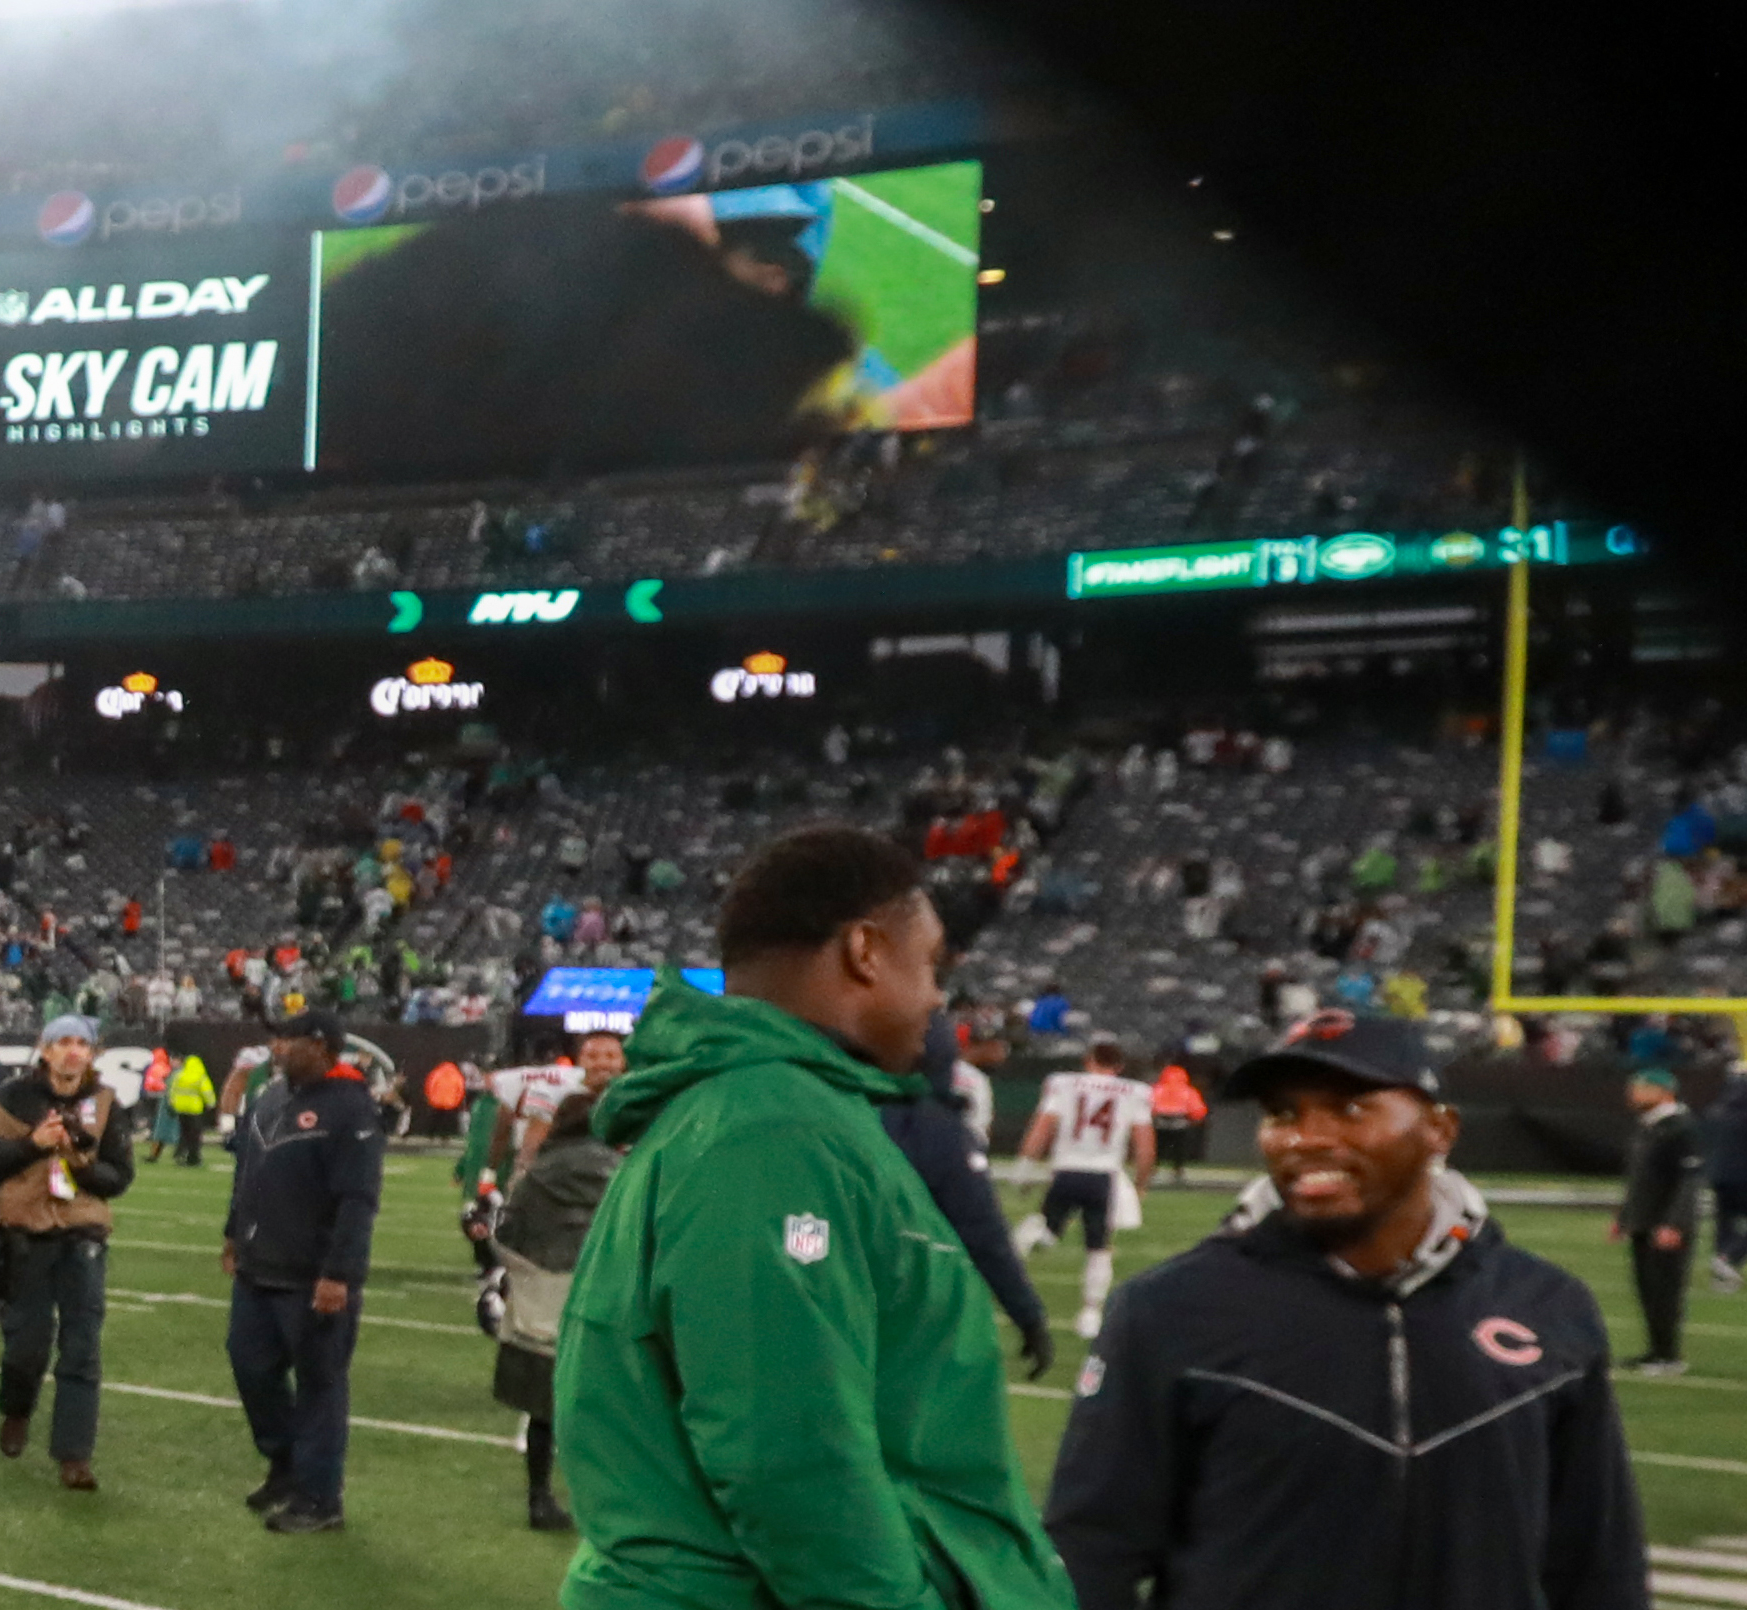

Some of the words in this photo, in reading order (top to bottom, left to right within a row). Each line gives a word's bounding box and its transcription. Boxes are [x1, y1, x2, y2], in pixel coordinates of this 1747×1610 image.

[710, 115, 873, 180] pepsi
[393, 154, 545, 212] pepsi
[103, 187, 241, 238] pepsi
[29, 284, 134, 325] ALL
[136, 273, 271, 319] DAY
[3, 348, 129, 423] SKY
[130, 339, 279, 417] CAM
[6, 415, 210, 444] HIGHLIGHTS
[466, 589, 581, 625] NYJ
[1072, 1091, 1115, 1144] 14
